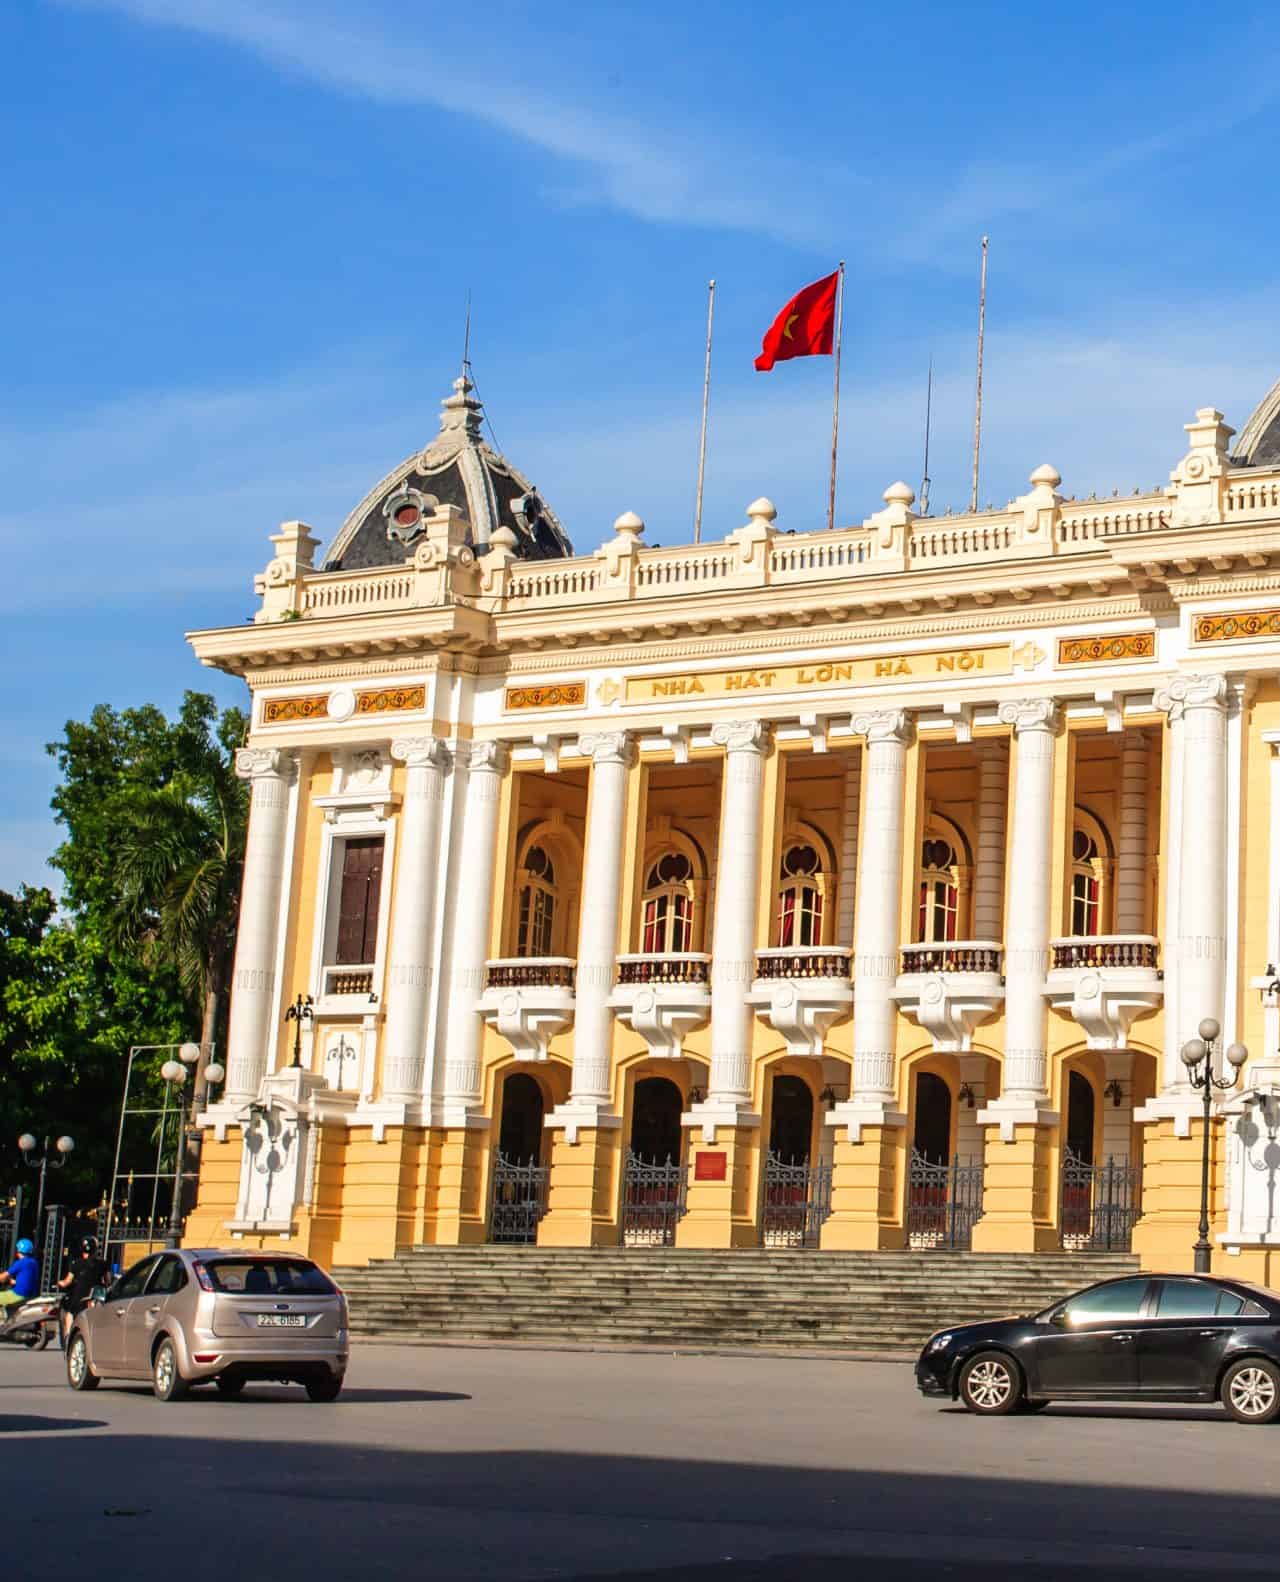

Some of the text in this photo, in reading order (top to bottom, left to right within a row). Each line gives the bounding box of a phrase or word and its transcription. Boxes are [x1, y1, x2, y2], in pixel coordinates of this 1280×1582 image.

[651, 676, 705, 696] NHÀ
[724, 671, 777, 690] HÁT
[874, 656, 913, 677] HÀ
[935, 651, 985, 672] NỘI
